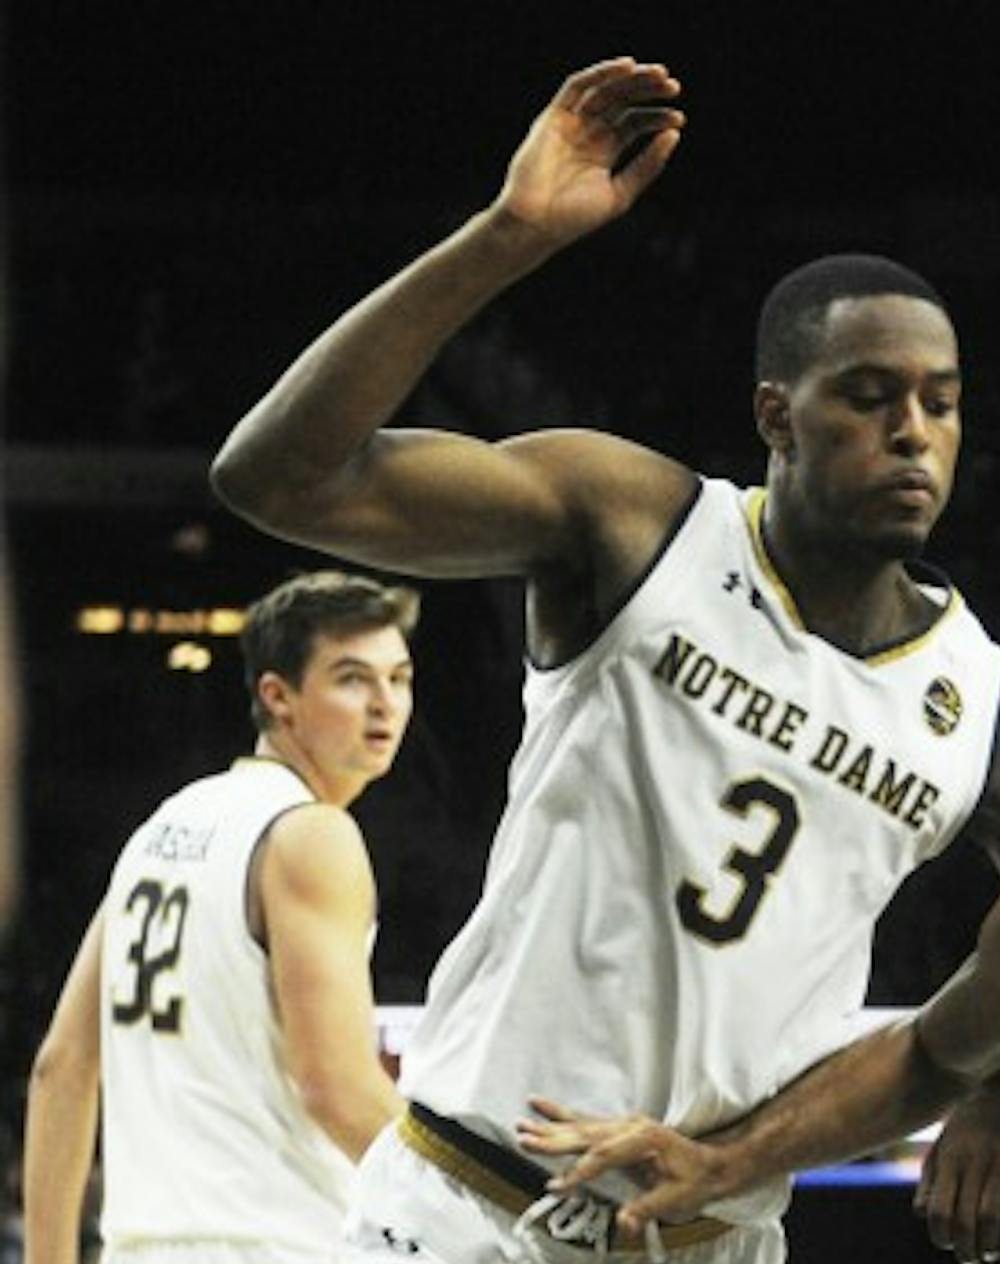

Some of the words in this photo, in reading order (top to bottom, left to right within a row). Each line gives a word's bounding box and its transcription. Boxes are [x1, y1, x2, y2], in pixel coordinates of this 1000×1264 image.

[653, 634, 808, 753] NOTRE
[809, 725, 939, 831] DAME
[674, 775, 801, 947] 3
[112, 878, 189, 1034] 32
